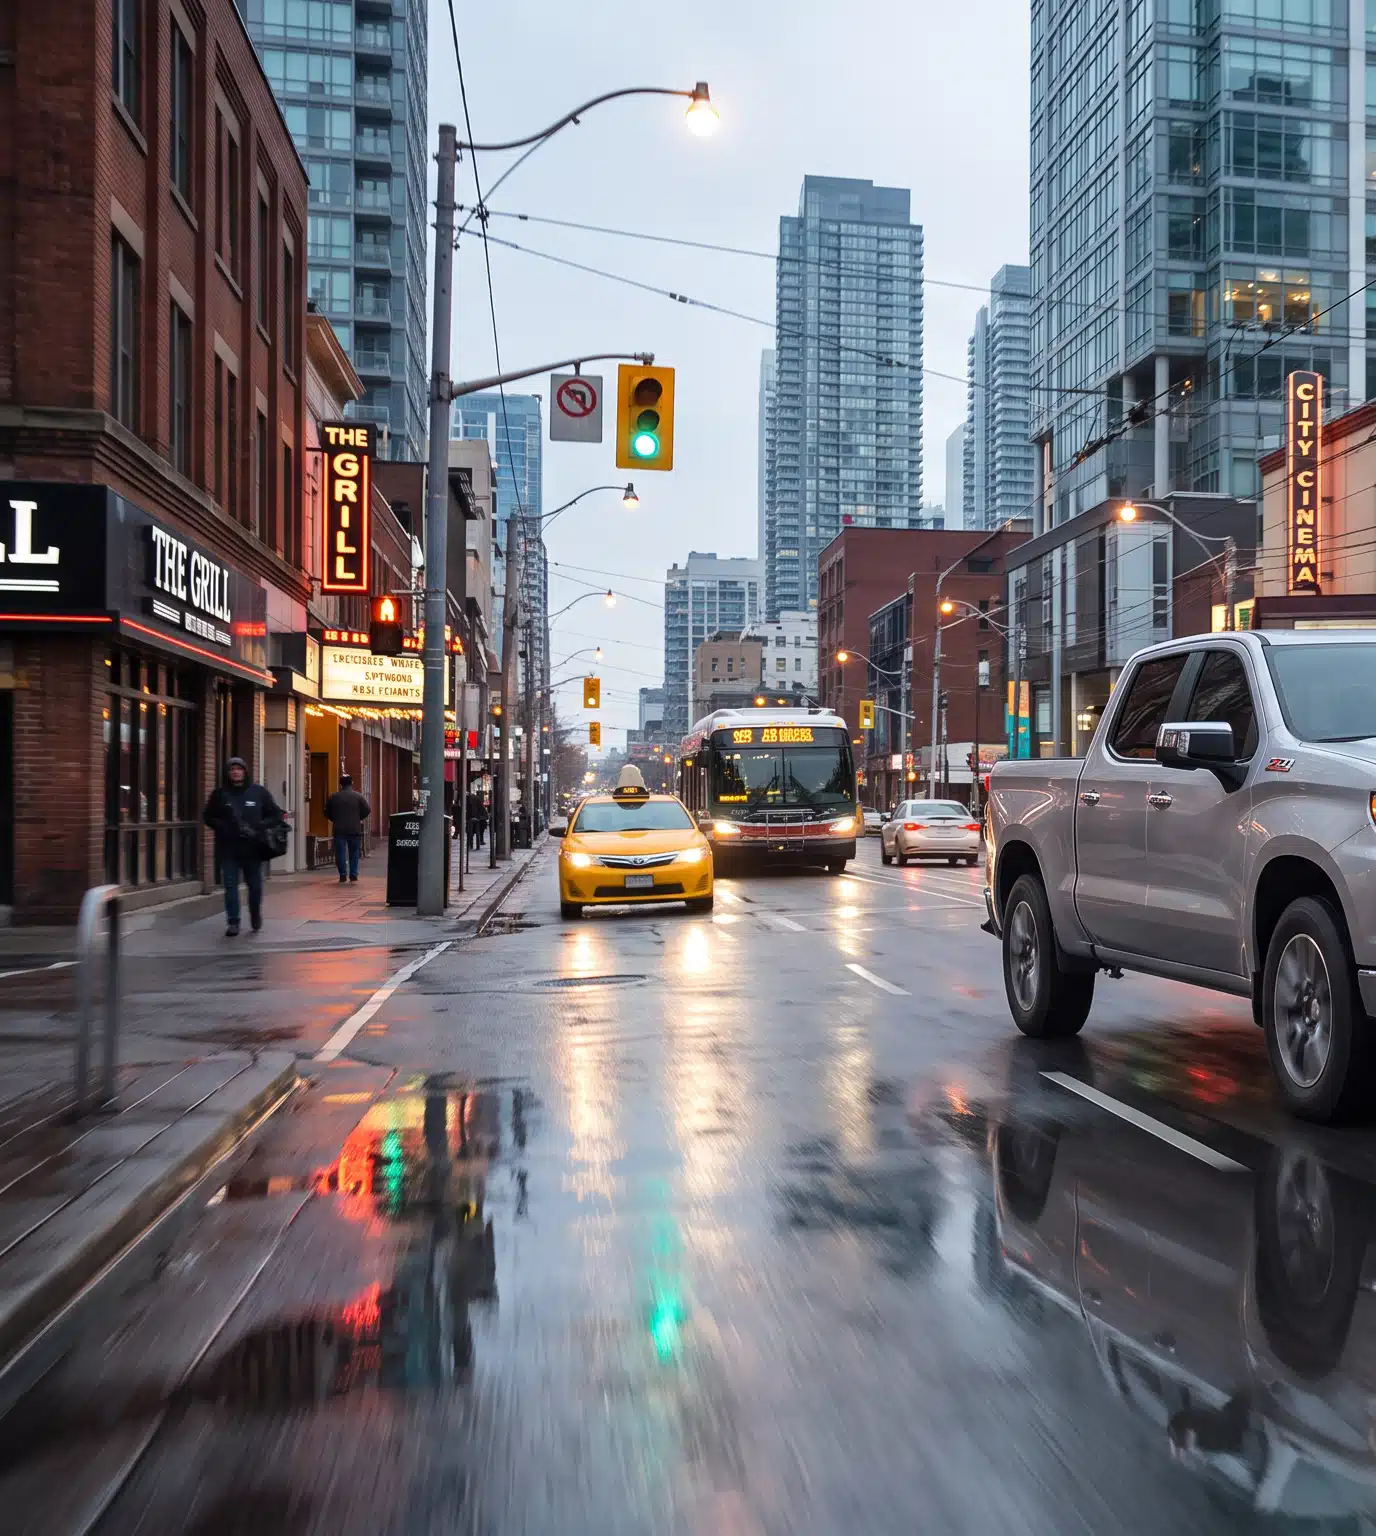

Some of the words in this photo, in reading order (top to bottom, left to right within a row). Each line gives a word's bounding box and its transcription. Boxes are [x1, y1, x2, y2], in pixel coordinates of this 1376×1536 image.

[324, 426, 368, 447] THE
[1296, 383, 1314, 456] CITY
[0, 500, 60, 565] L
[333, 453, 359, 579] GRILL
[1294, 471, 1316, 582] CINEMA
[152, 525, 188, 601] THE
[190, 550, 231, 623] GRILL
